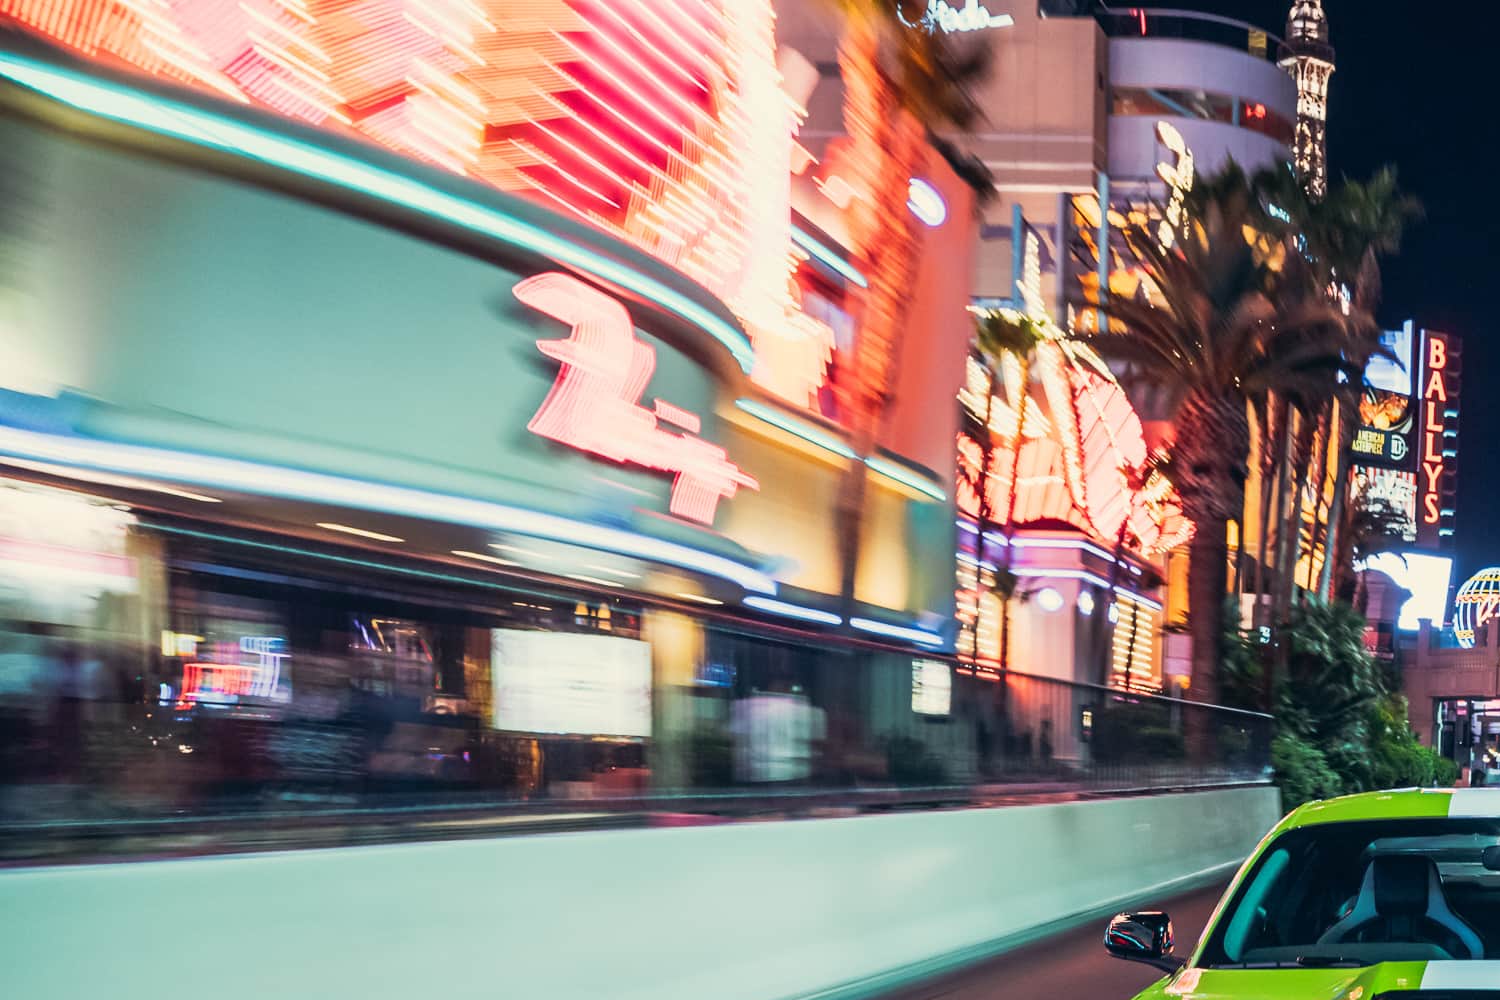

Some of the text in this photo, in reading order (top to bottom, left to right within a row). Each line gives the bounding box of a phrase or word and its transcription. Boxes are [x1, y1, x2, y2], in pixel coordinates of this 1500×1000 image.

[1357, 429, 1385, 445] AMERICAN
[1423, 337, 1447, 524] BALLYS
[1351, 439, 1384, 455] ASTERPIECE
